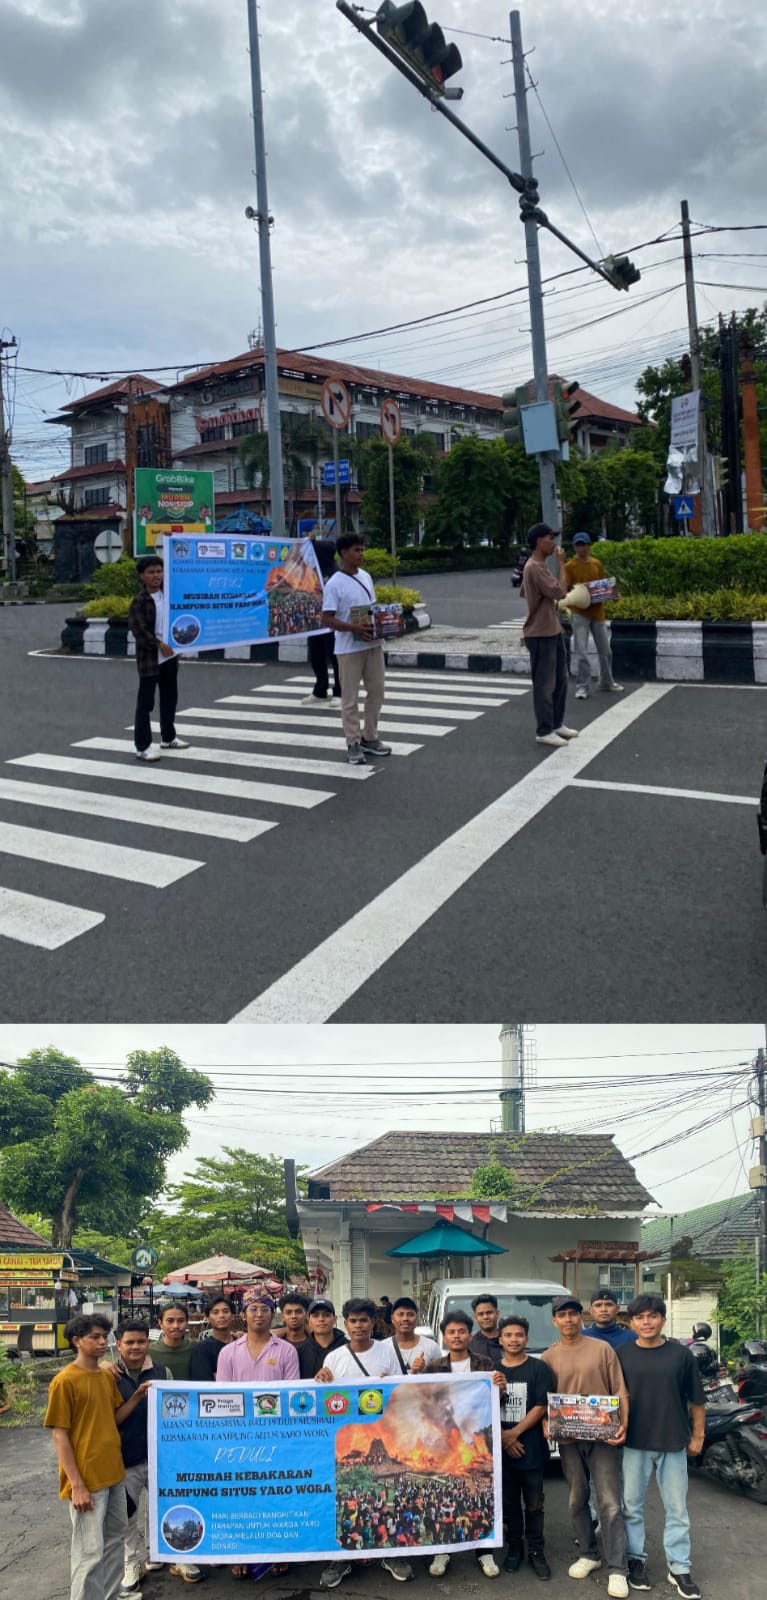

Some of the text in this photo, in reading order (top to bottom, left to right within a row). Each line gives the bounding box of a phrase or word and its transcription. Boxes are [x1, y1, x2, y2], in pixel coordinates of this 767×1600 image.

[155, 473, 195, 484] GrabBike
[161, 1421, 193, 1429] ALIANSI
[195, 1419, 246, 1428] MAHASISWA
[298, 1416, 336, 1425] MUSIBAH
[161, 1429, 329, 1442] KEBAKARAN KAMPUNG SITUS YARO WORA
[214, 1446, 277, 1464] PEDULI
[176, 1469, 312, 1483] MUSIBAH KEBAKARAN
[158, 1483, 332, 1498] KAMPUNG SITUS YARO WORA
[211, 1511, 229, 1520] MARI
[230, 1511, 261, 1520] BERBAGI
[246, 1521, 270, 1529] UNTUK
[272, 1520, 299, 1529] WARGA
[300, 1519, 320, 1528] YARO
[266, 1531, 282, 1540] DOA
[283, 1530, 299, 1539] DAN
[211, 1542, 238, 1551] DONASI
